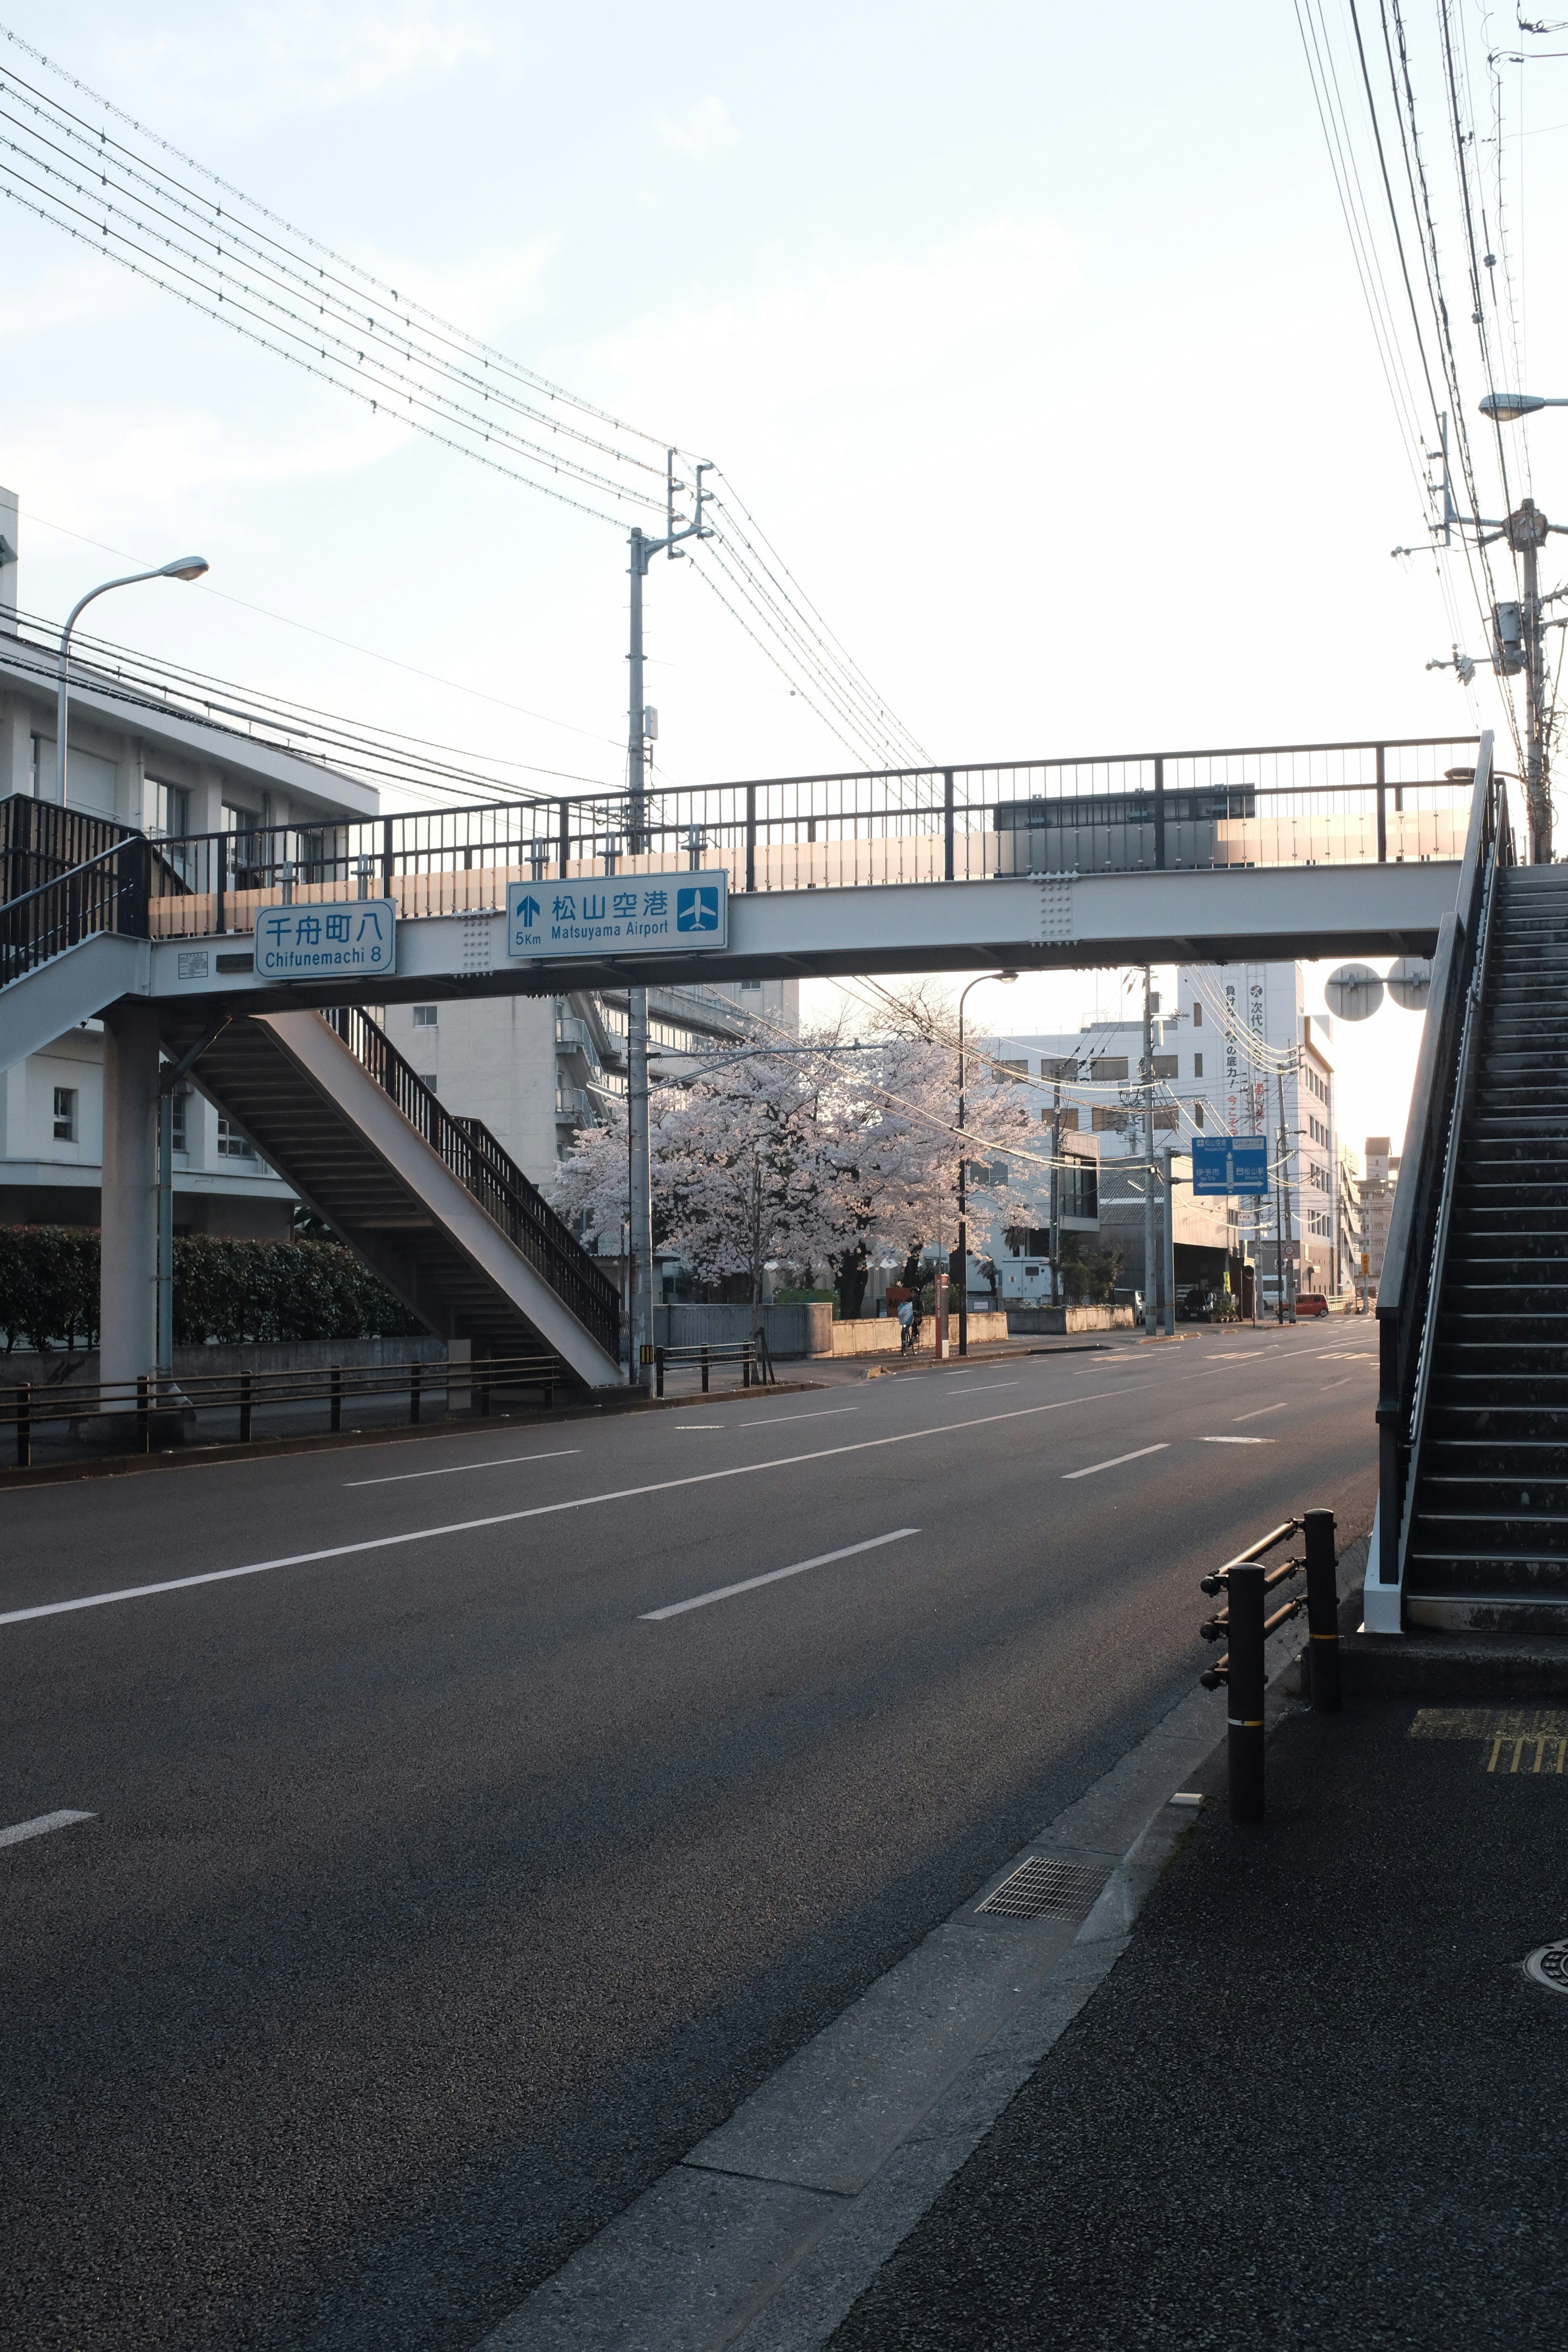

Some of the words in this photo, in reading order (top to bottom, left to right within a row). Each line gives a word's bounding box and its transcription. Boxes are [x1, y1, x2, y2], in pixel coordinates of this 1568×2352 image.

[552, 890, 668, 921] 松山空港
[266, 913, 383, 947] 千舟町八
[516, 932, 541, 945] 5Km
[551, 924, 620, 941] Matsuyama
[626, 920, 668, 938] Airport
[265, 947, 364, 968] Chifunemachi
[371, 946, 381, 962] 8
